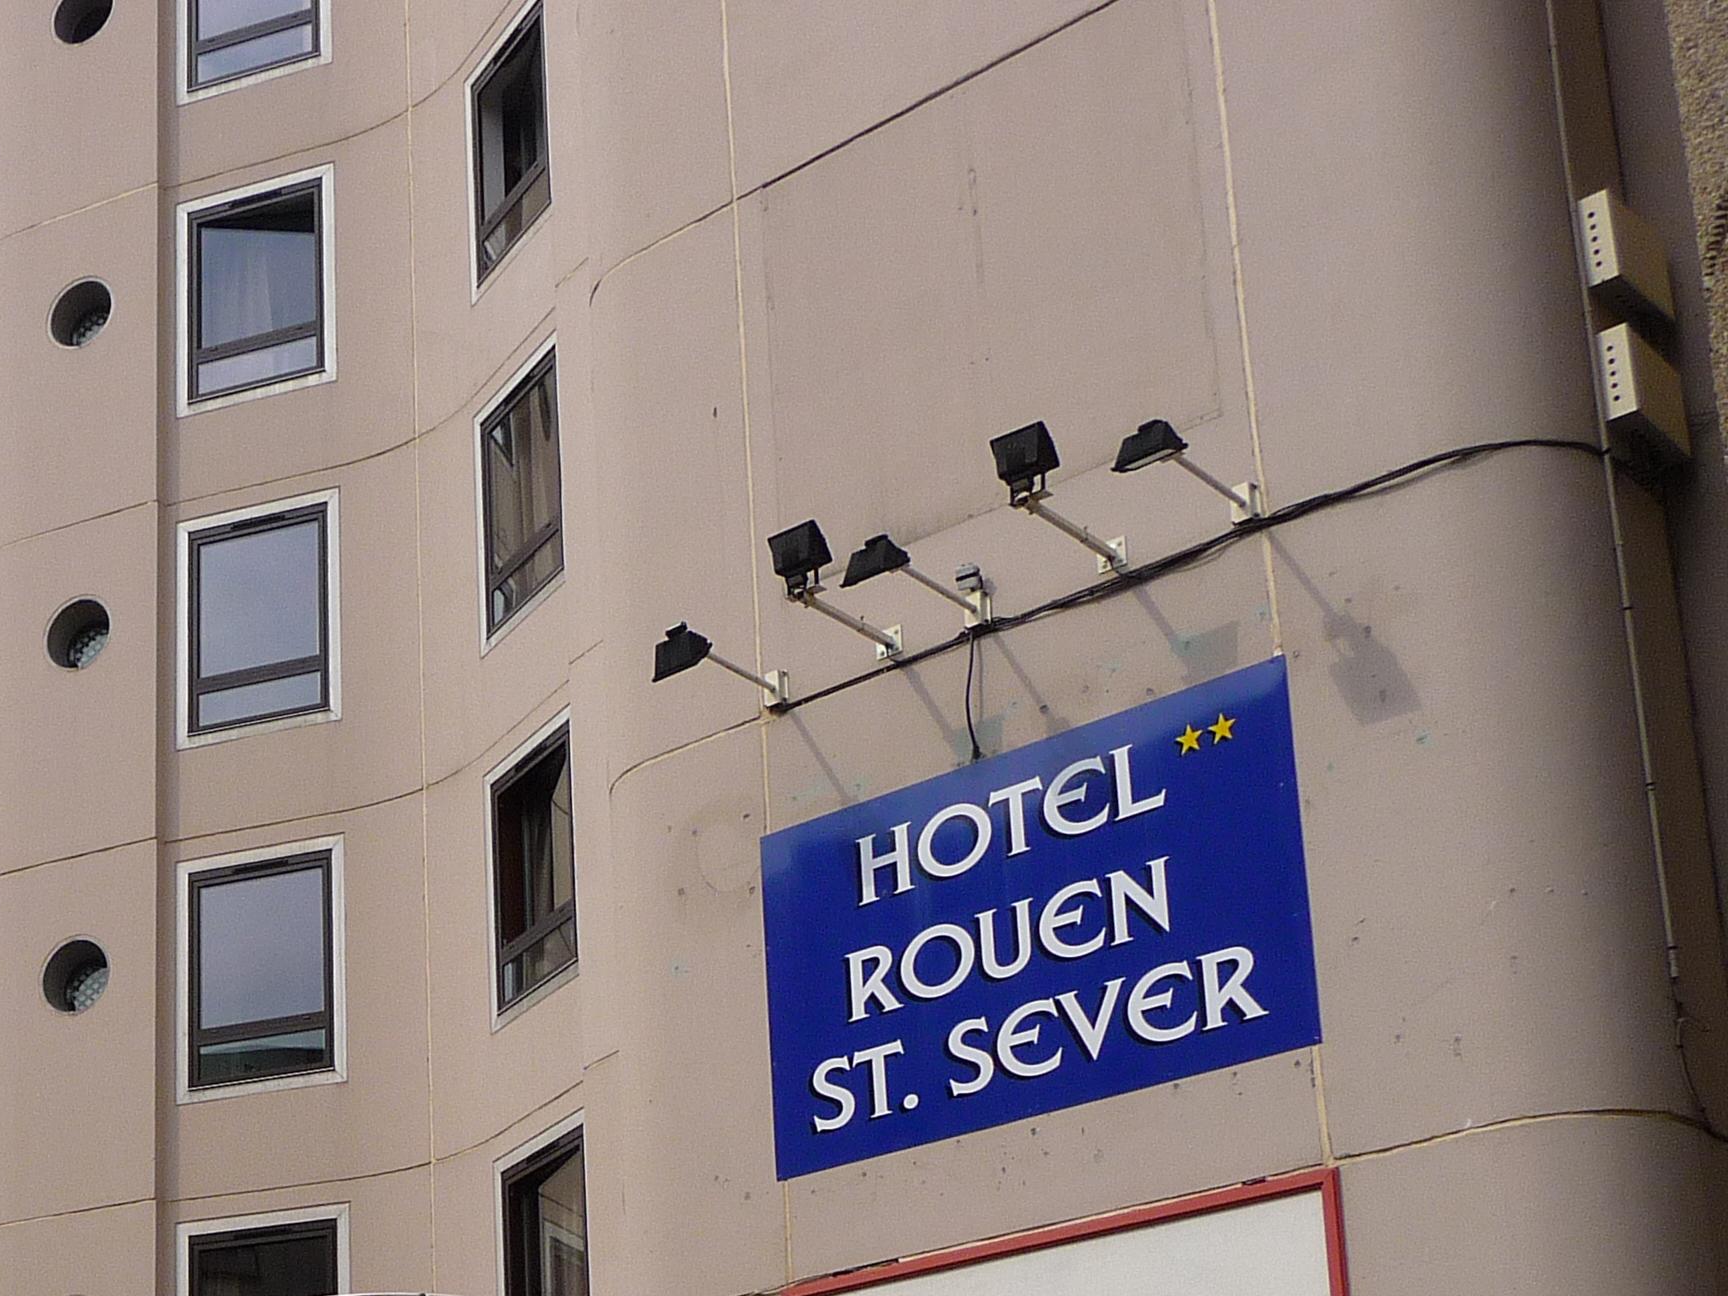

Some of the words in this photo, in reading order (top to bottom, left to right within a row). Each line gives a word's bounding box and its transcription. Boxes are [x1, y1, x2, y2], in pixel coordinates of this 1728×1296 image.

[855, 743, 1167, 906] HOTEL
[845, 855, 1171, 1023] ROUEN
[810, 1040, 920, 1133] ST.
[946, 945, 1270, 1099] SEVER
